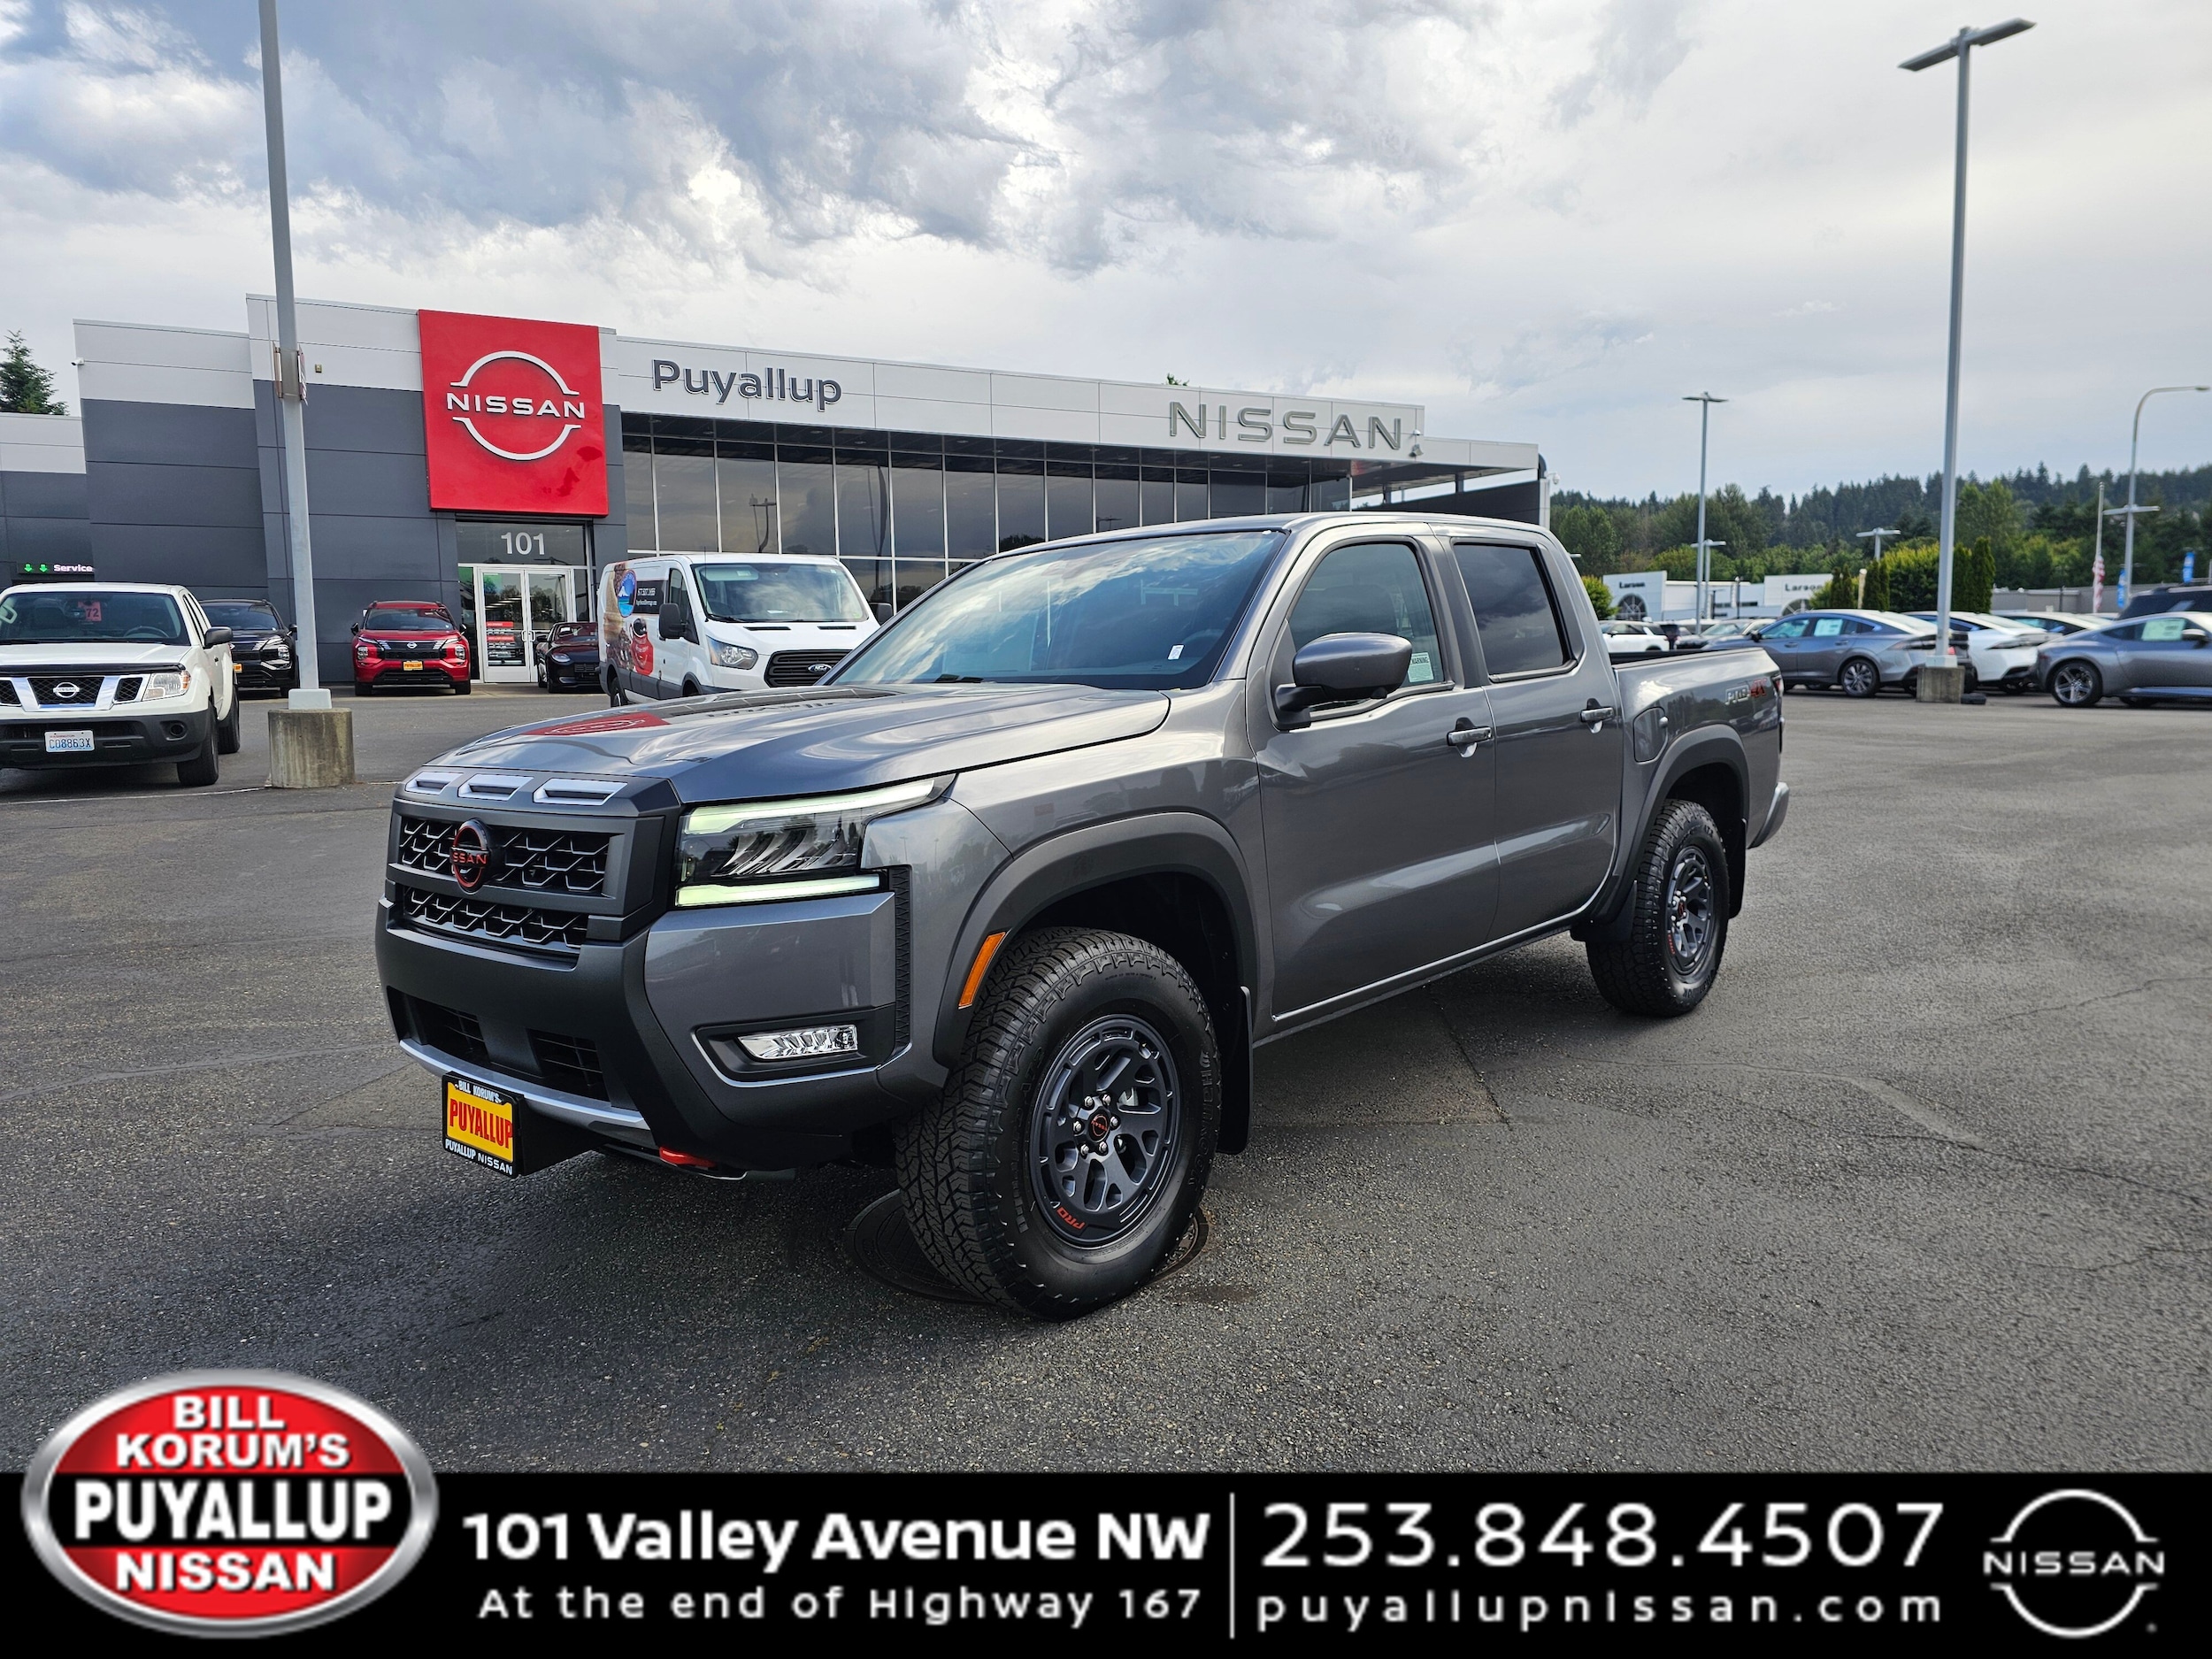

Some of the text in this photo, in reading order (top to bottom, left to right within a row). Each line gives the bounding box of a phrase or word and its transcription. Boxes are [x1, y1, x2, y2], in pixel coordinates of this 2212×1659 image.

[652, 359, 842, 411] Puyallup
[446, 392, 585, 419] NISSAN
[1169, 401, 1402, 449] NISSAN
[501, 532, 545, 556] 101
[53, 564, 94, 572] Service
[457, 1079, 501, 1102] BILL KORUM'S
[449, 1098, 513, 1148] PUYALLUP
[445, 1139, 512, 1175] PUYALLUP NISSAN
